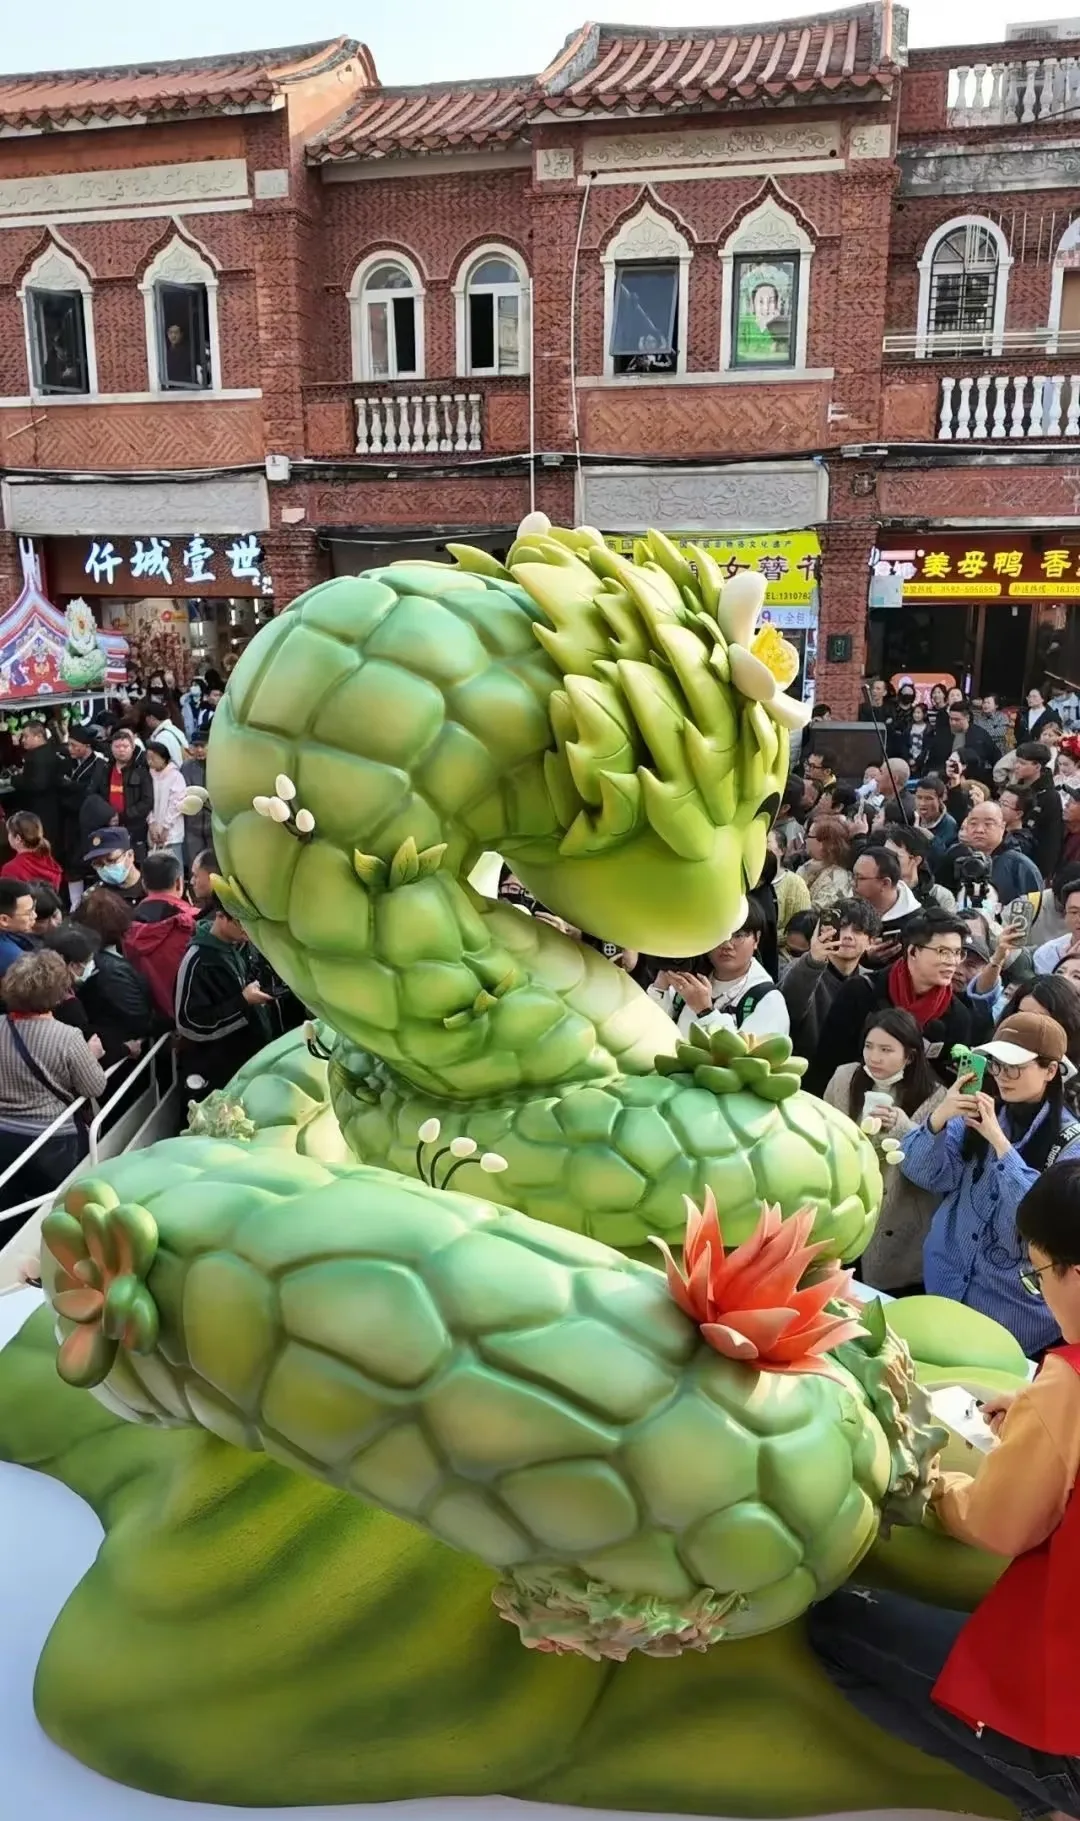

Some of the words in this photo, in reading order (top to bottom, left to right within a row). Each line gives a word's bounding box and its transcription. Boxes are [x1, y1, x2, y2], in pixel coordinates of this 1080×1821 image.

[85, 533, 262, 585] 仟城壹世
[685, 555, 822, 582] 女簪花
[921, 550, 1024, 578] 姜母鸭
[1040, 550, 1080, 578] 香
